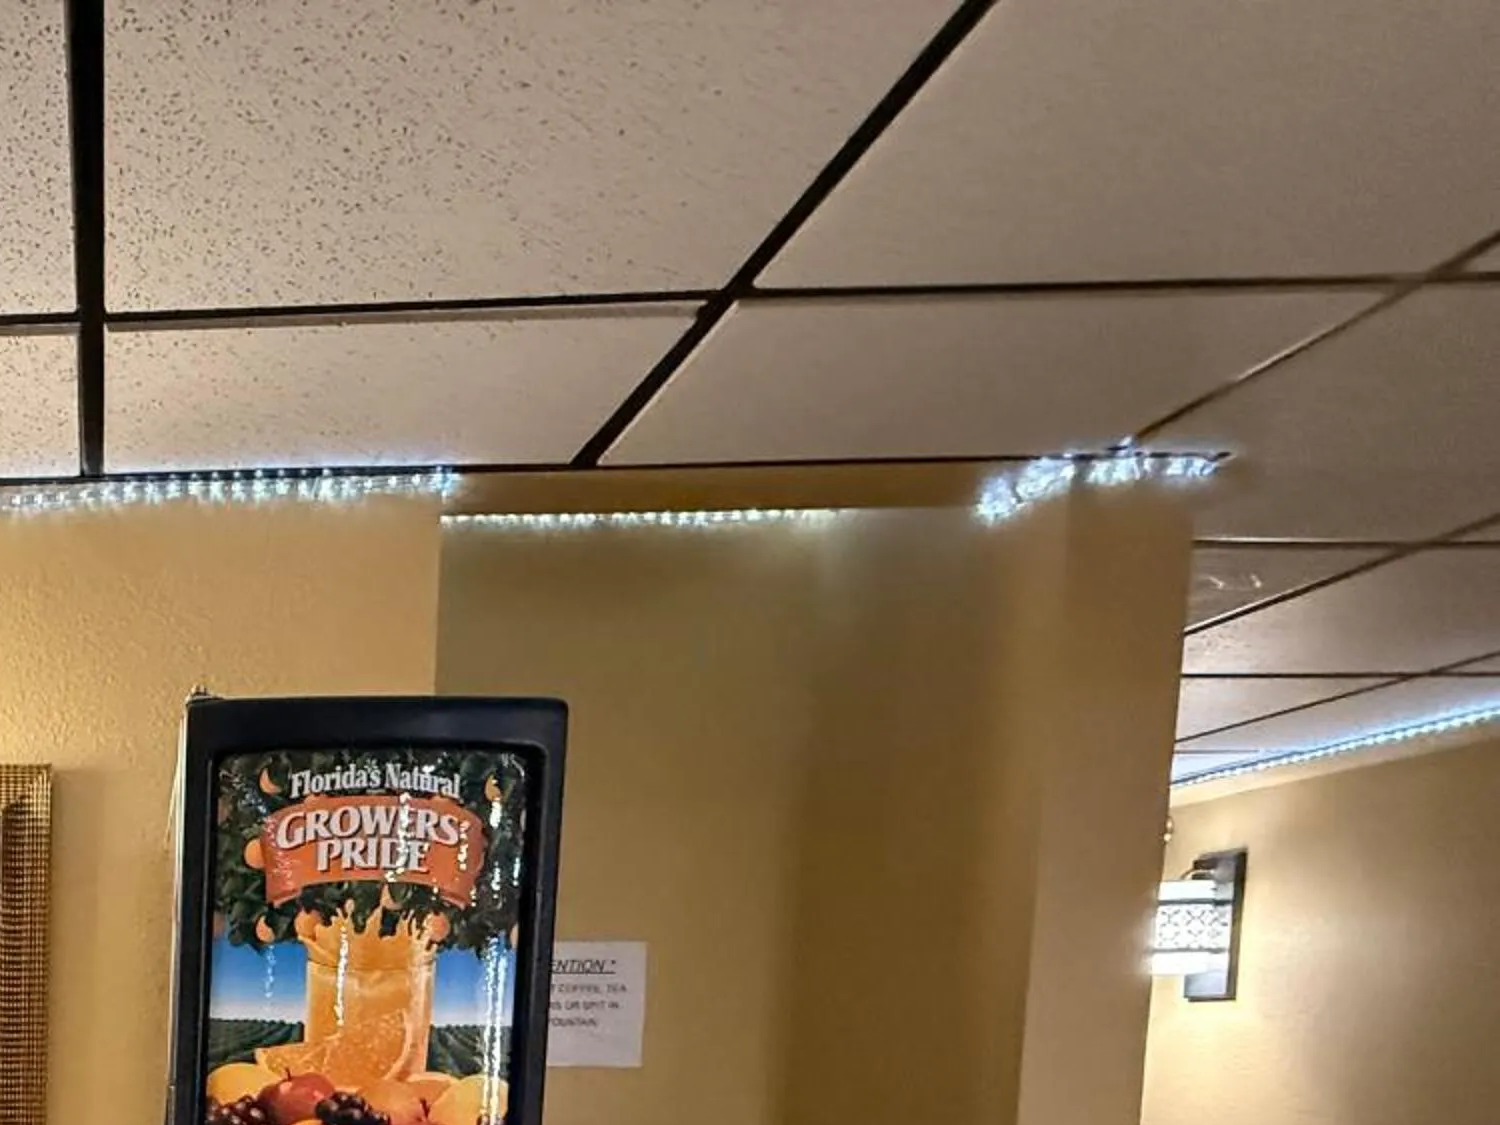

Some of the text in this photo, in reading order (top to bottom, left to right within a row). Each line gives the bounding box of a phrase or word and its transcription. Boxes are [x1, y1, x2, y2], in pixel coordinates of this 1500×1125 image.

[289, 763, 461, 799] Florida's Natural
[276, 805, 460, 849] GROWERS
[316, 837, 429, 873] PRIDE
[551, 959, 605, 974] ENTION
